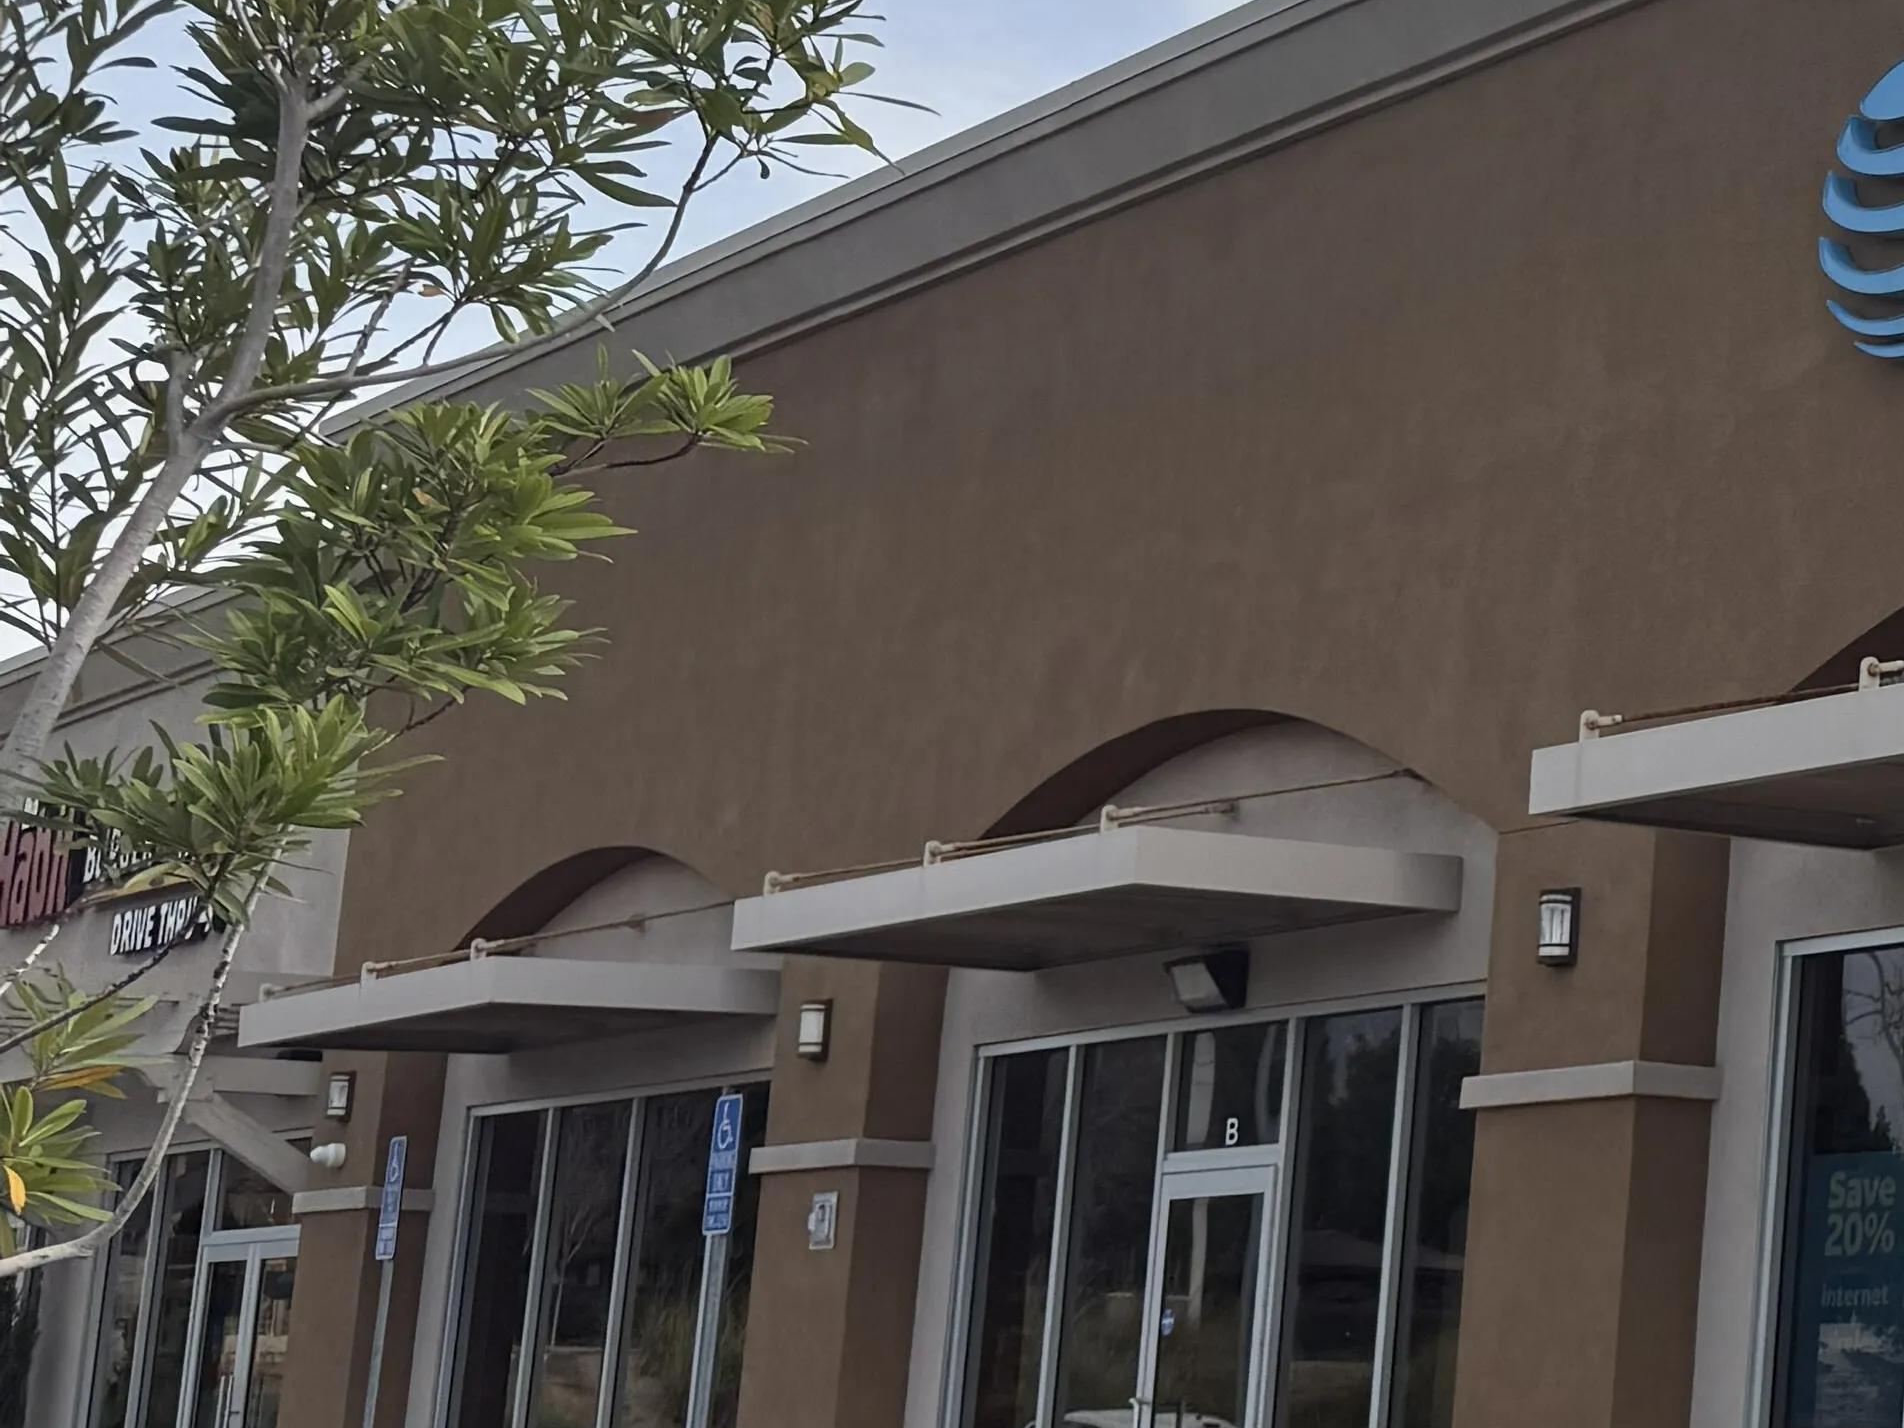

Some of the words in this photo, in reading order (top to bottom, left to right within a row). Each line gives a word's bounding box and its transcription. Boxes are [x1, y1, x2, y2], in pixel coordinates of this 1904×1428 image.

[110, 905, 157, 956] DRIVE
[1226, 1117, 1239, 1146] B
[1827, 1170, 1897, 1211] Save
[1823, 1210, 1896, 1257] 20%
[1820, 1281, 1890, 1309] internet
